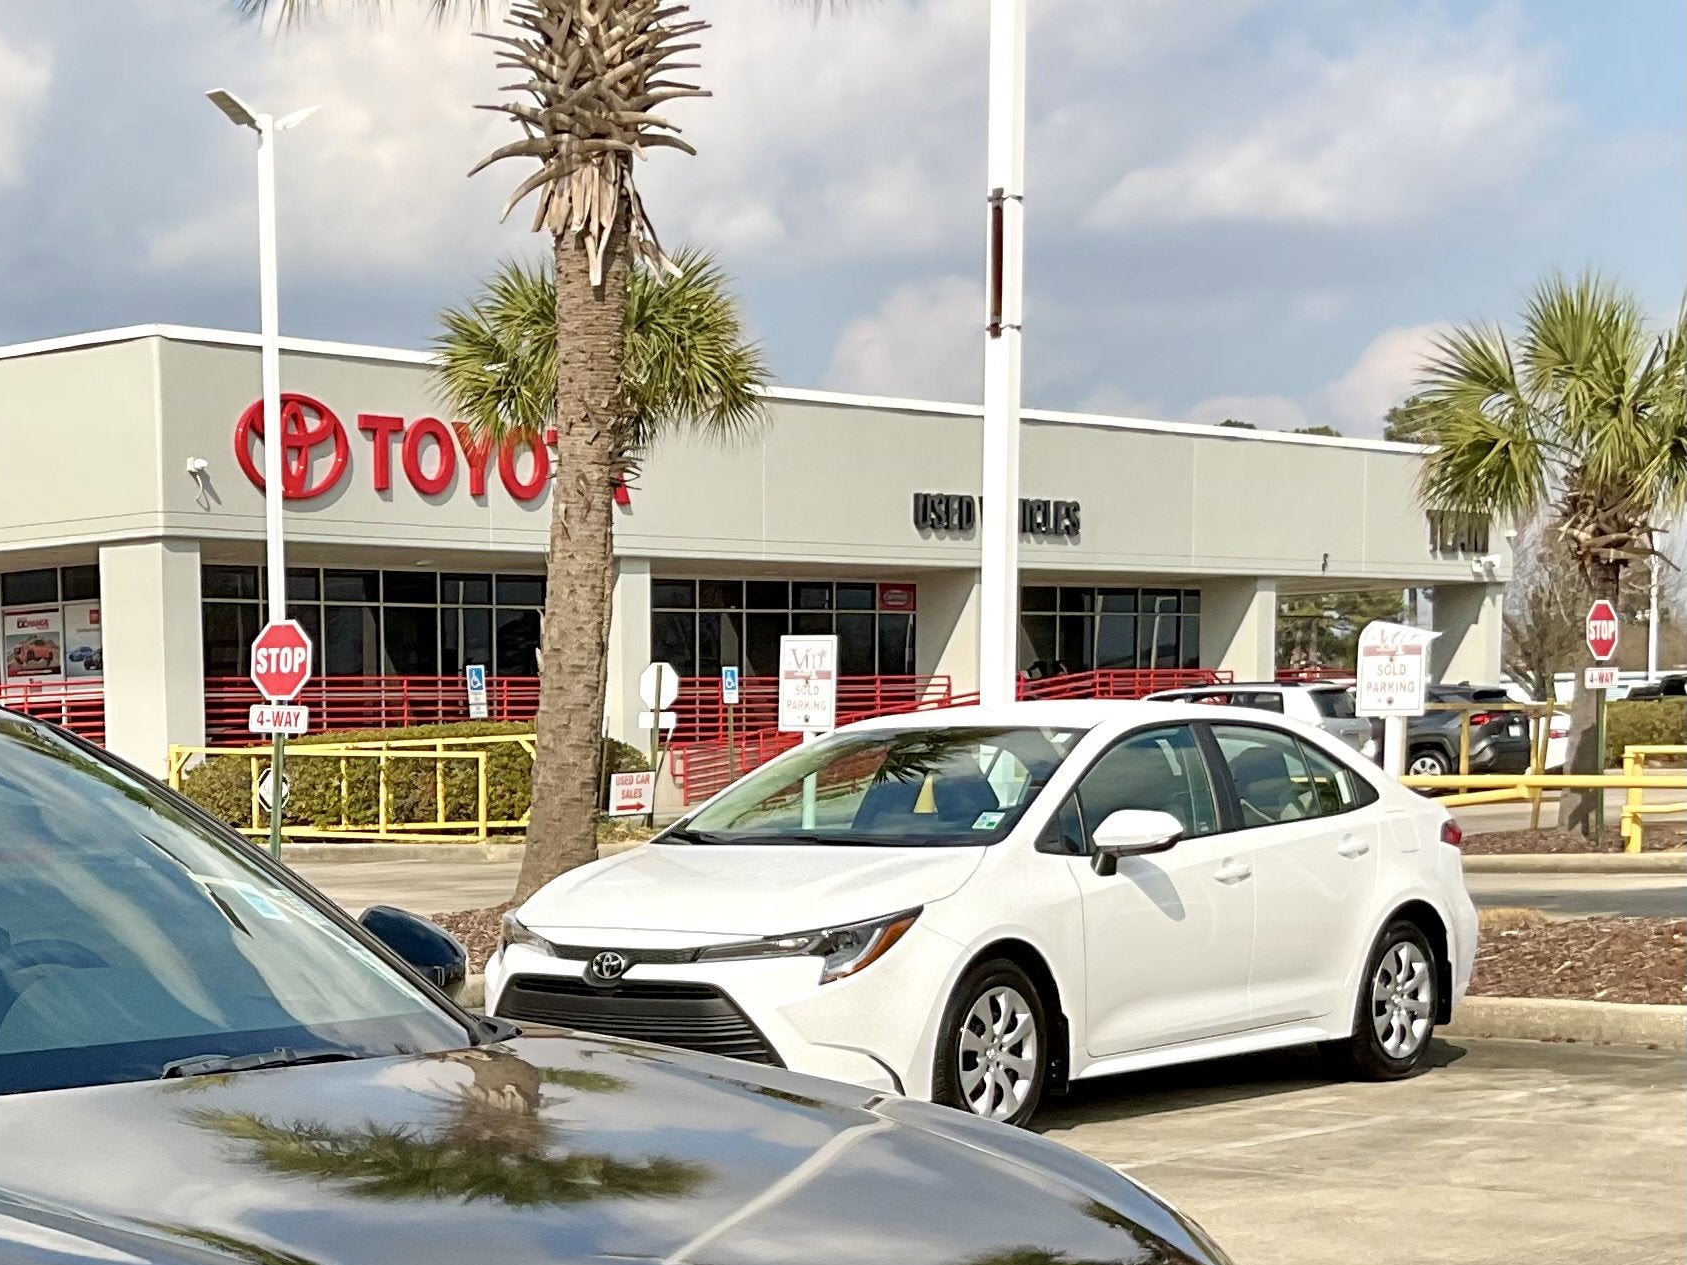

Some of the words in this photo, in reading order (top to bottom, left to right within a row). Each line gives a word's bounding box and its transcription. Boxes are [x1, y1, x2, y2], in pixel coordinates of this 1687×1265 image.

[357, 414, 631, 505] TOYO
[913, 492, 976, 531] USED
[1589, 619, 1615, 641] STOP
[255, 646, 307, 675] STOP
[1377, 663, 1407, 677] SOLD
[1589, 671, 1615, 684] 4-WAY
[794, 685, 820, 696] SOLD
[1366, 681, 1415, 693] PARKING
[786, 699, 827, 711] PARKING
[256, 710, 301, 728] 4-WAY
[615, 775, 634, 786] USED
[635, 773, 651, 785] CAR
[621, 788, 643, 800] SALES
